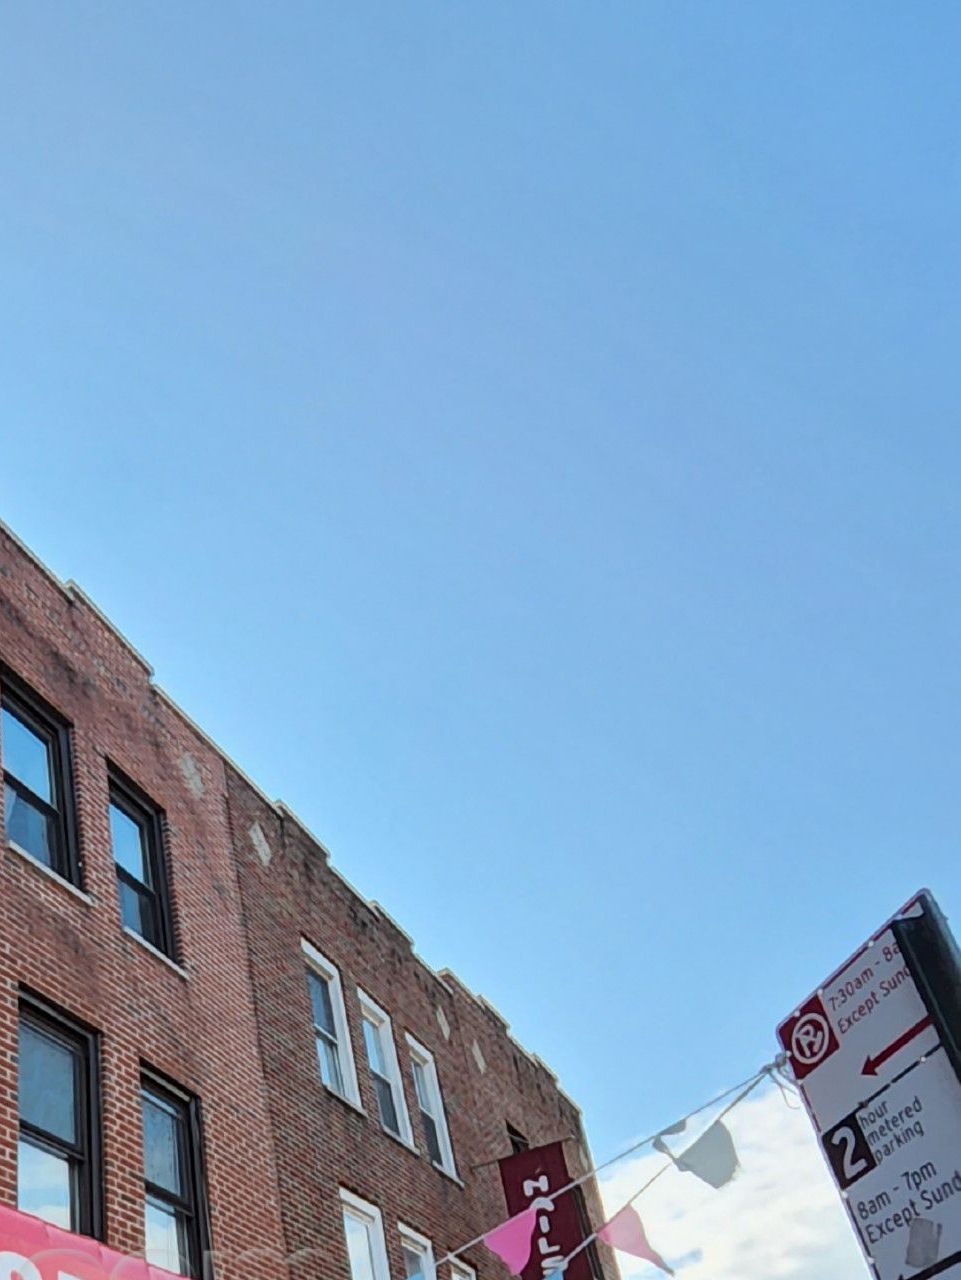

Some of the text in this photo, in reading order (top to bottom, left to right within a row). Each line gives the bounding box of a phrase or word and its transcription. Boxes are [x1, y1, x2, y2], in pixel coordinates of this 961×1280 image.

[828, 967, 874, 1011] 7:30am
[837, 991, 880, 1034] Except
[859, 1101, 889, 1130] hour
[867, 1096, 923, 1146] metered
[831, 1126, 868, 1180] 2
[874, 1121, 925, 1165] parking
[857, 1191, 891, 1220] 8am
[901, 1161, 937, 1191] 7pm
[865, 1199, 921, 1244] Except
